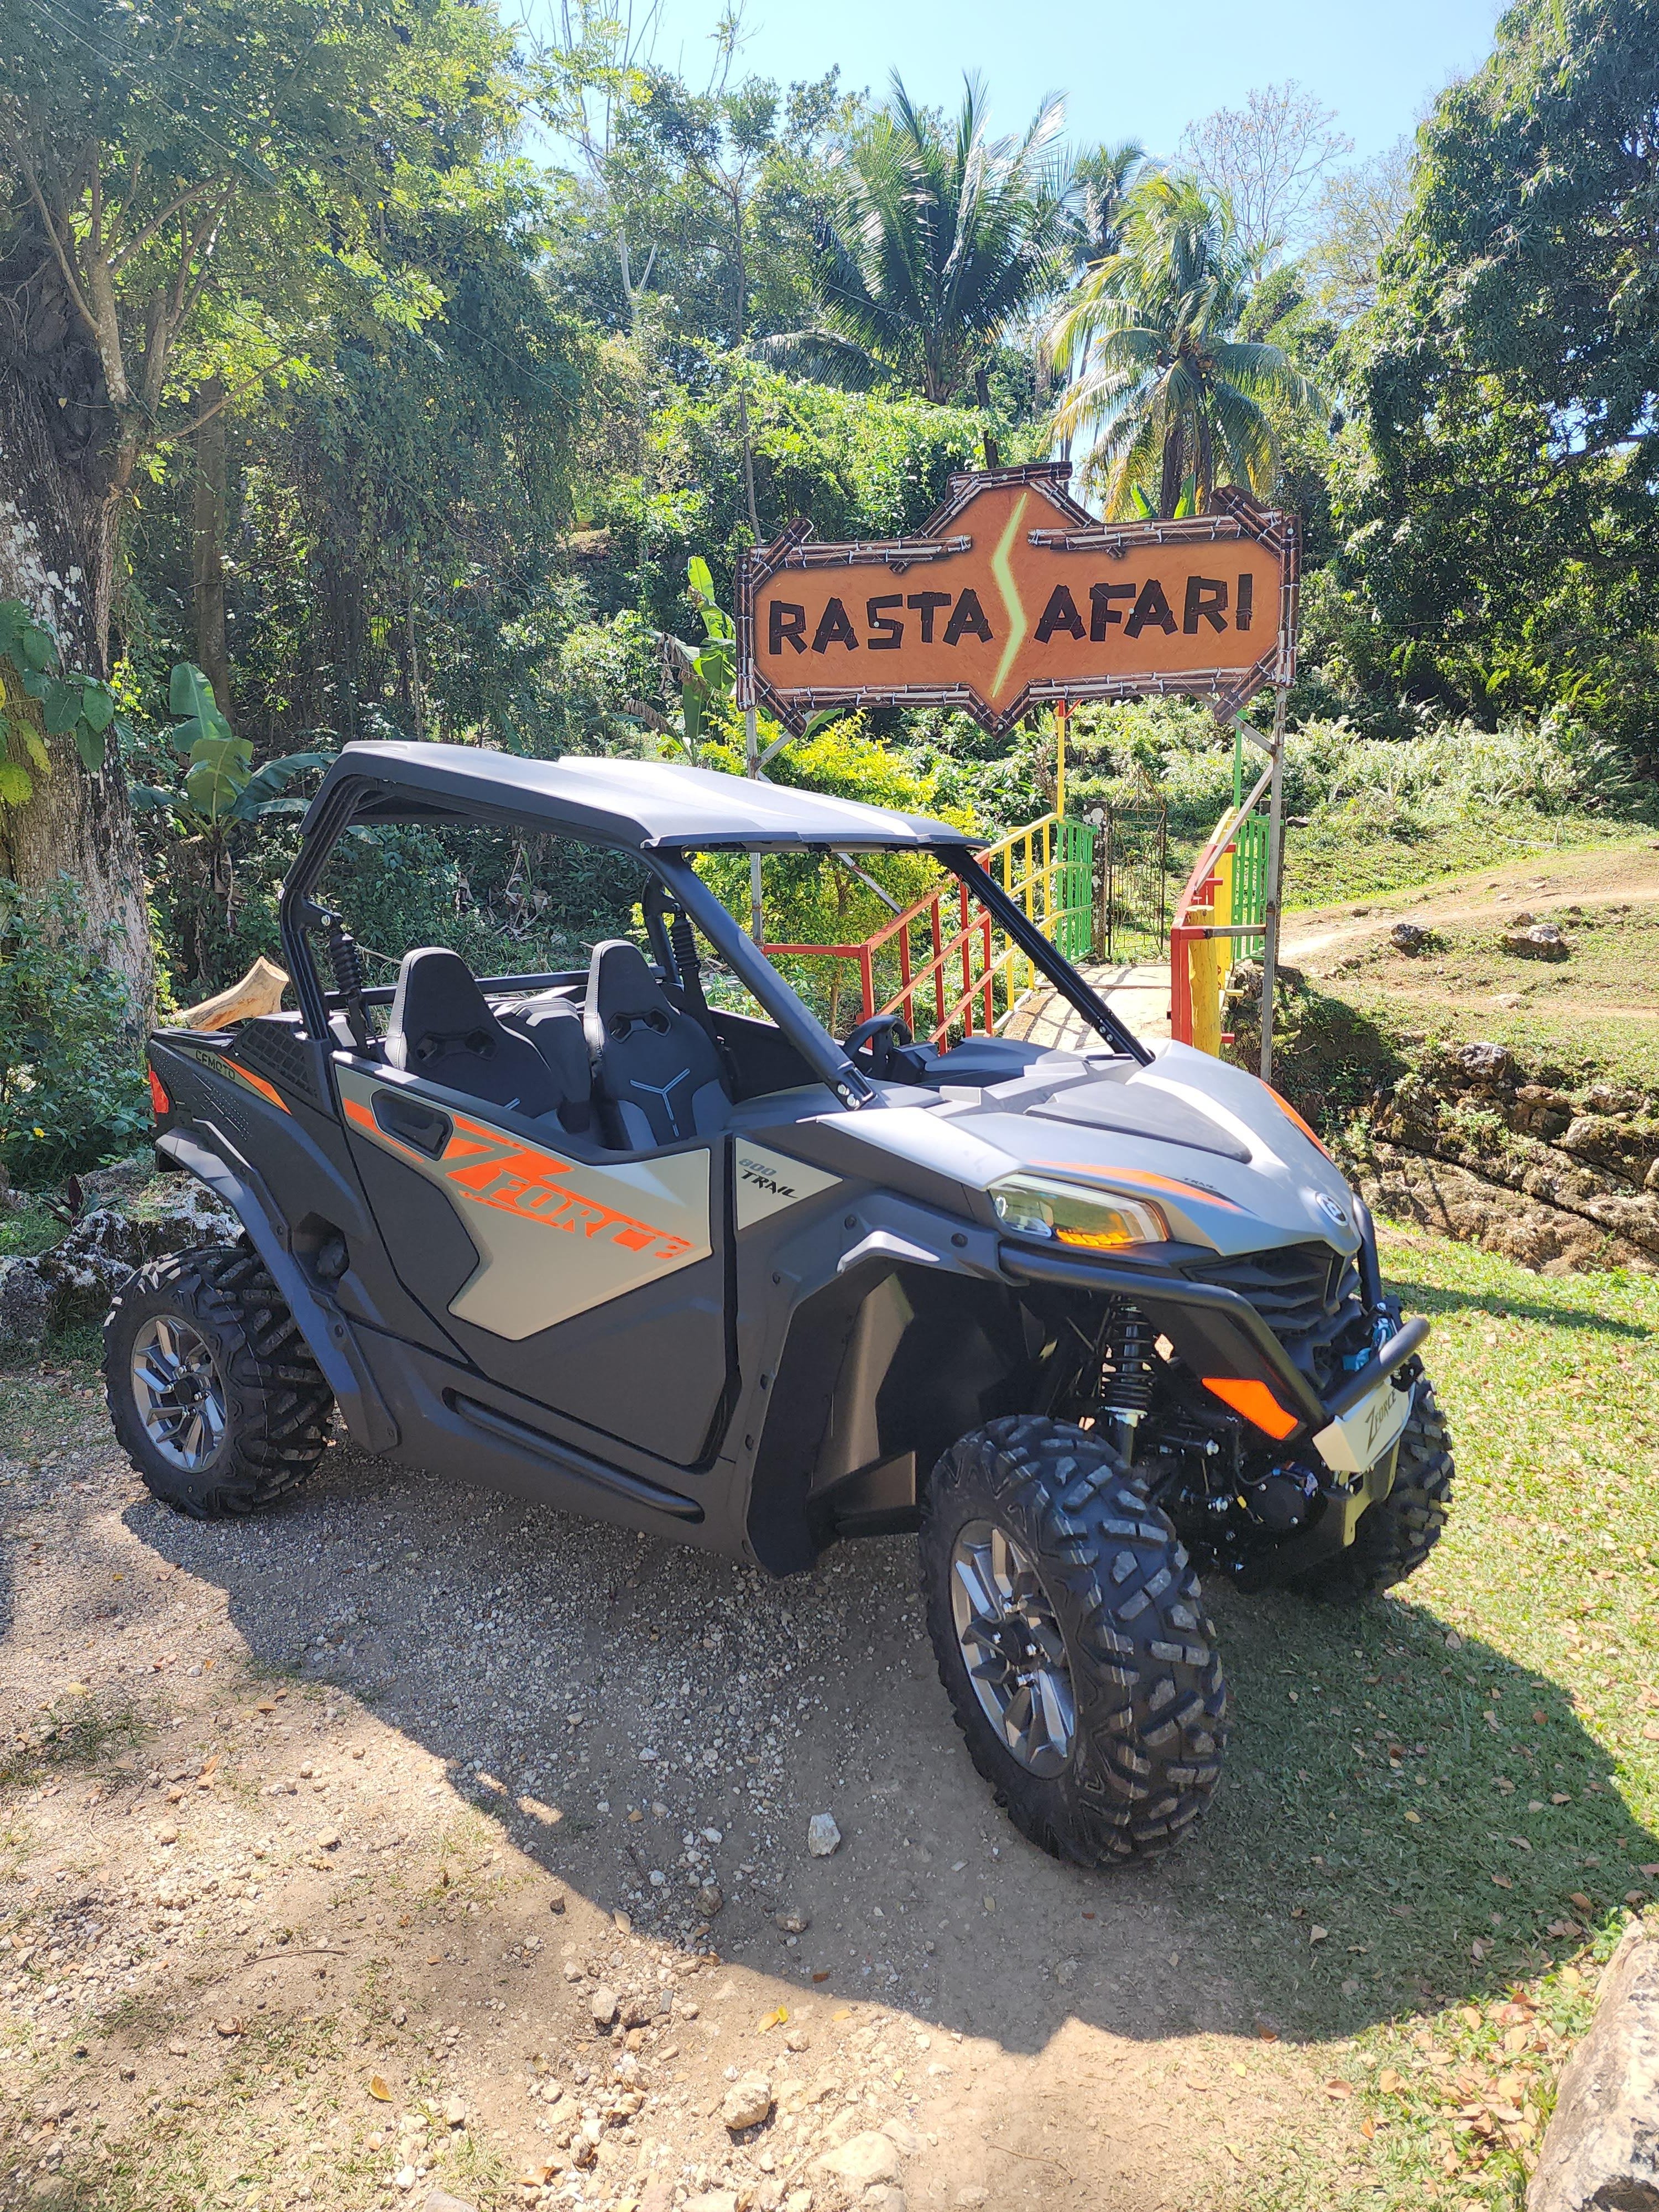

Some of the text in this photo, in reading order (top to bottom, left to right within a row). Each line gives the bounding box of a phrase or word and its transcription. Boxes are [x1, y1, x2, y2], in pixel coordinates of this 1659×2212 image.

[769, 588, 994, 654] RASTA
[195, 1050, 236, 1081] CFMOTO
[738, 1159, 776, 1176] 800
[740, 1168, 799, 1199] TRAIL
